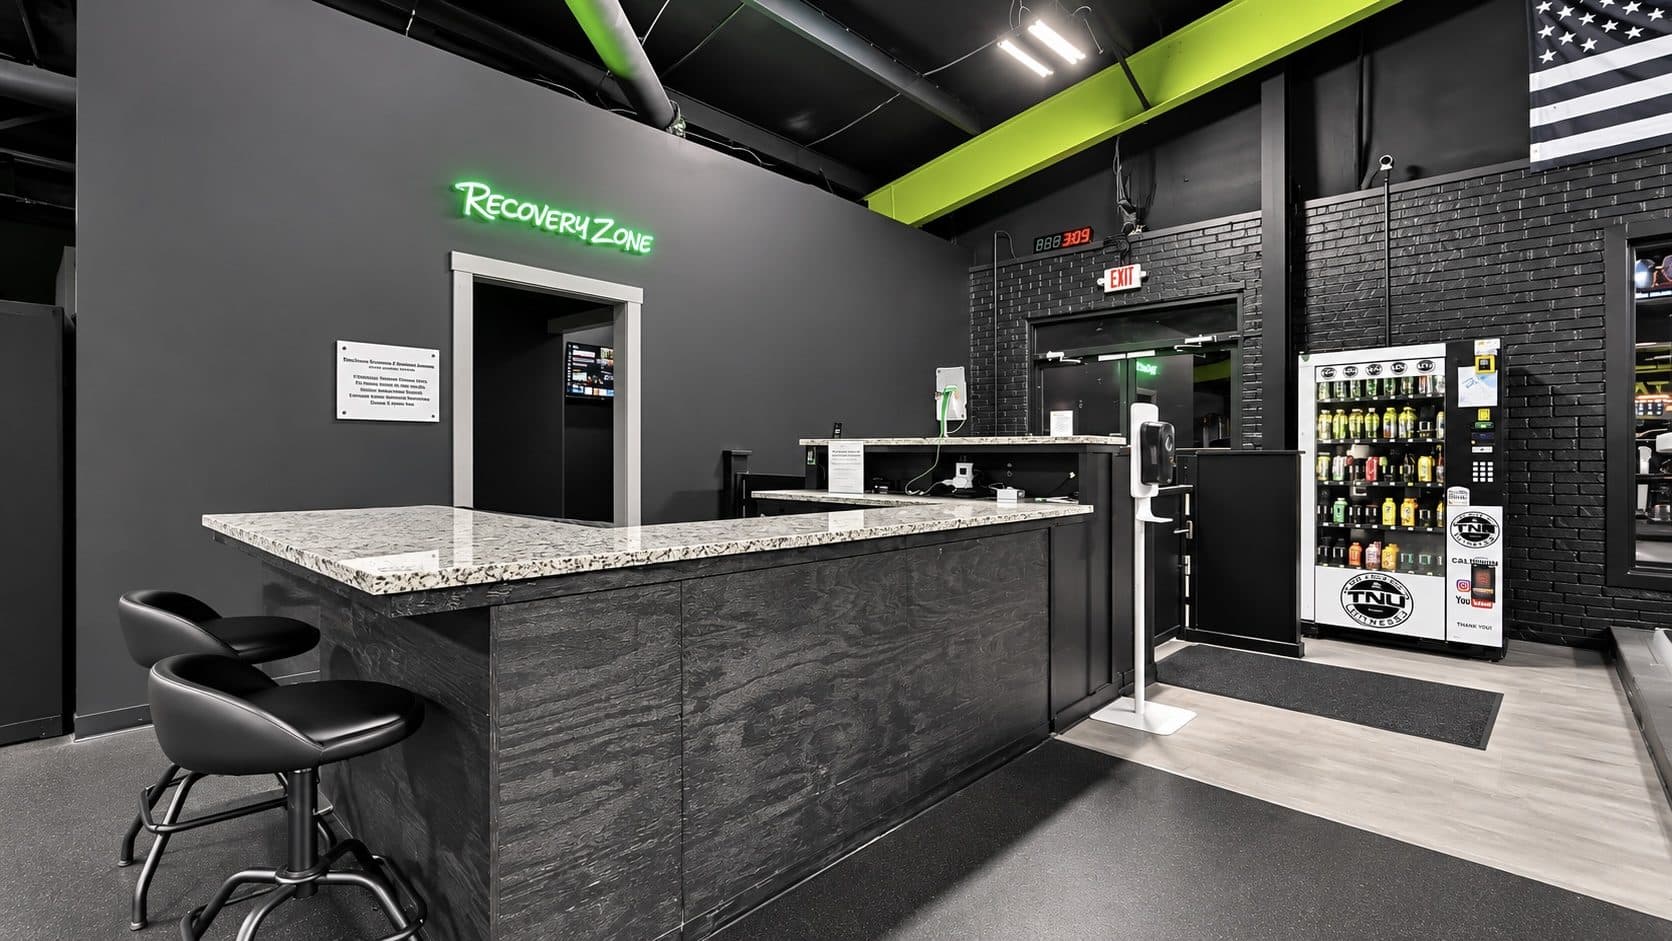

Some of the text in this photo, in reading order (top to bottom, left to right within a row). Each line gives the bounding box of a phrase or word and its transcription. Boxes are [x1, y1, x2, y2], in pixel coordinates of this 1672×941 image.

[1062, 228, 1090, 247] 3:09
[1110, 267, 1134, 289] EXIT
[1347, 591, 1406, 609] TNU
